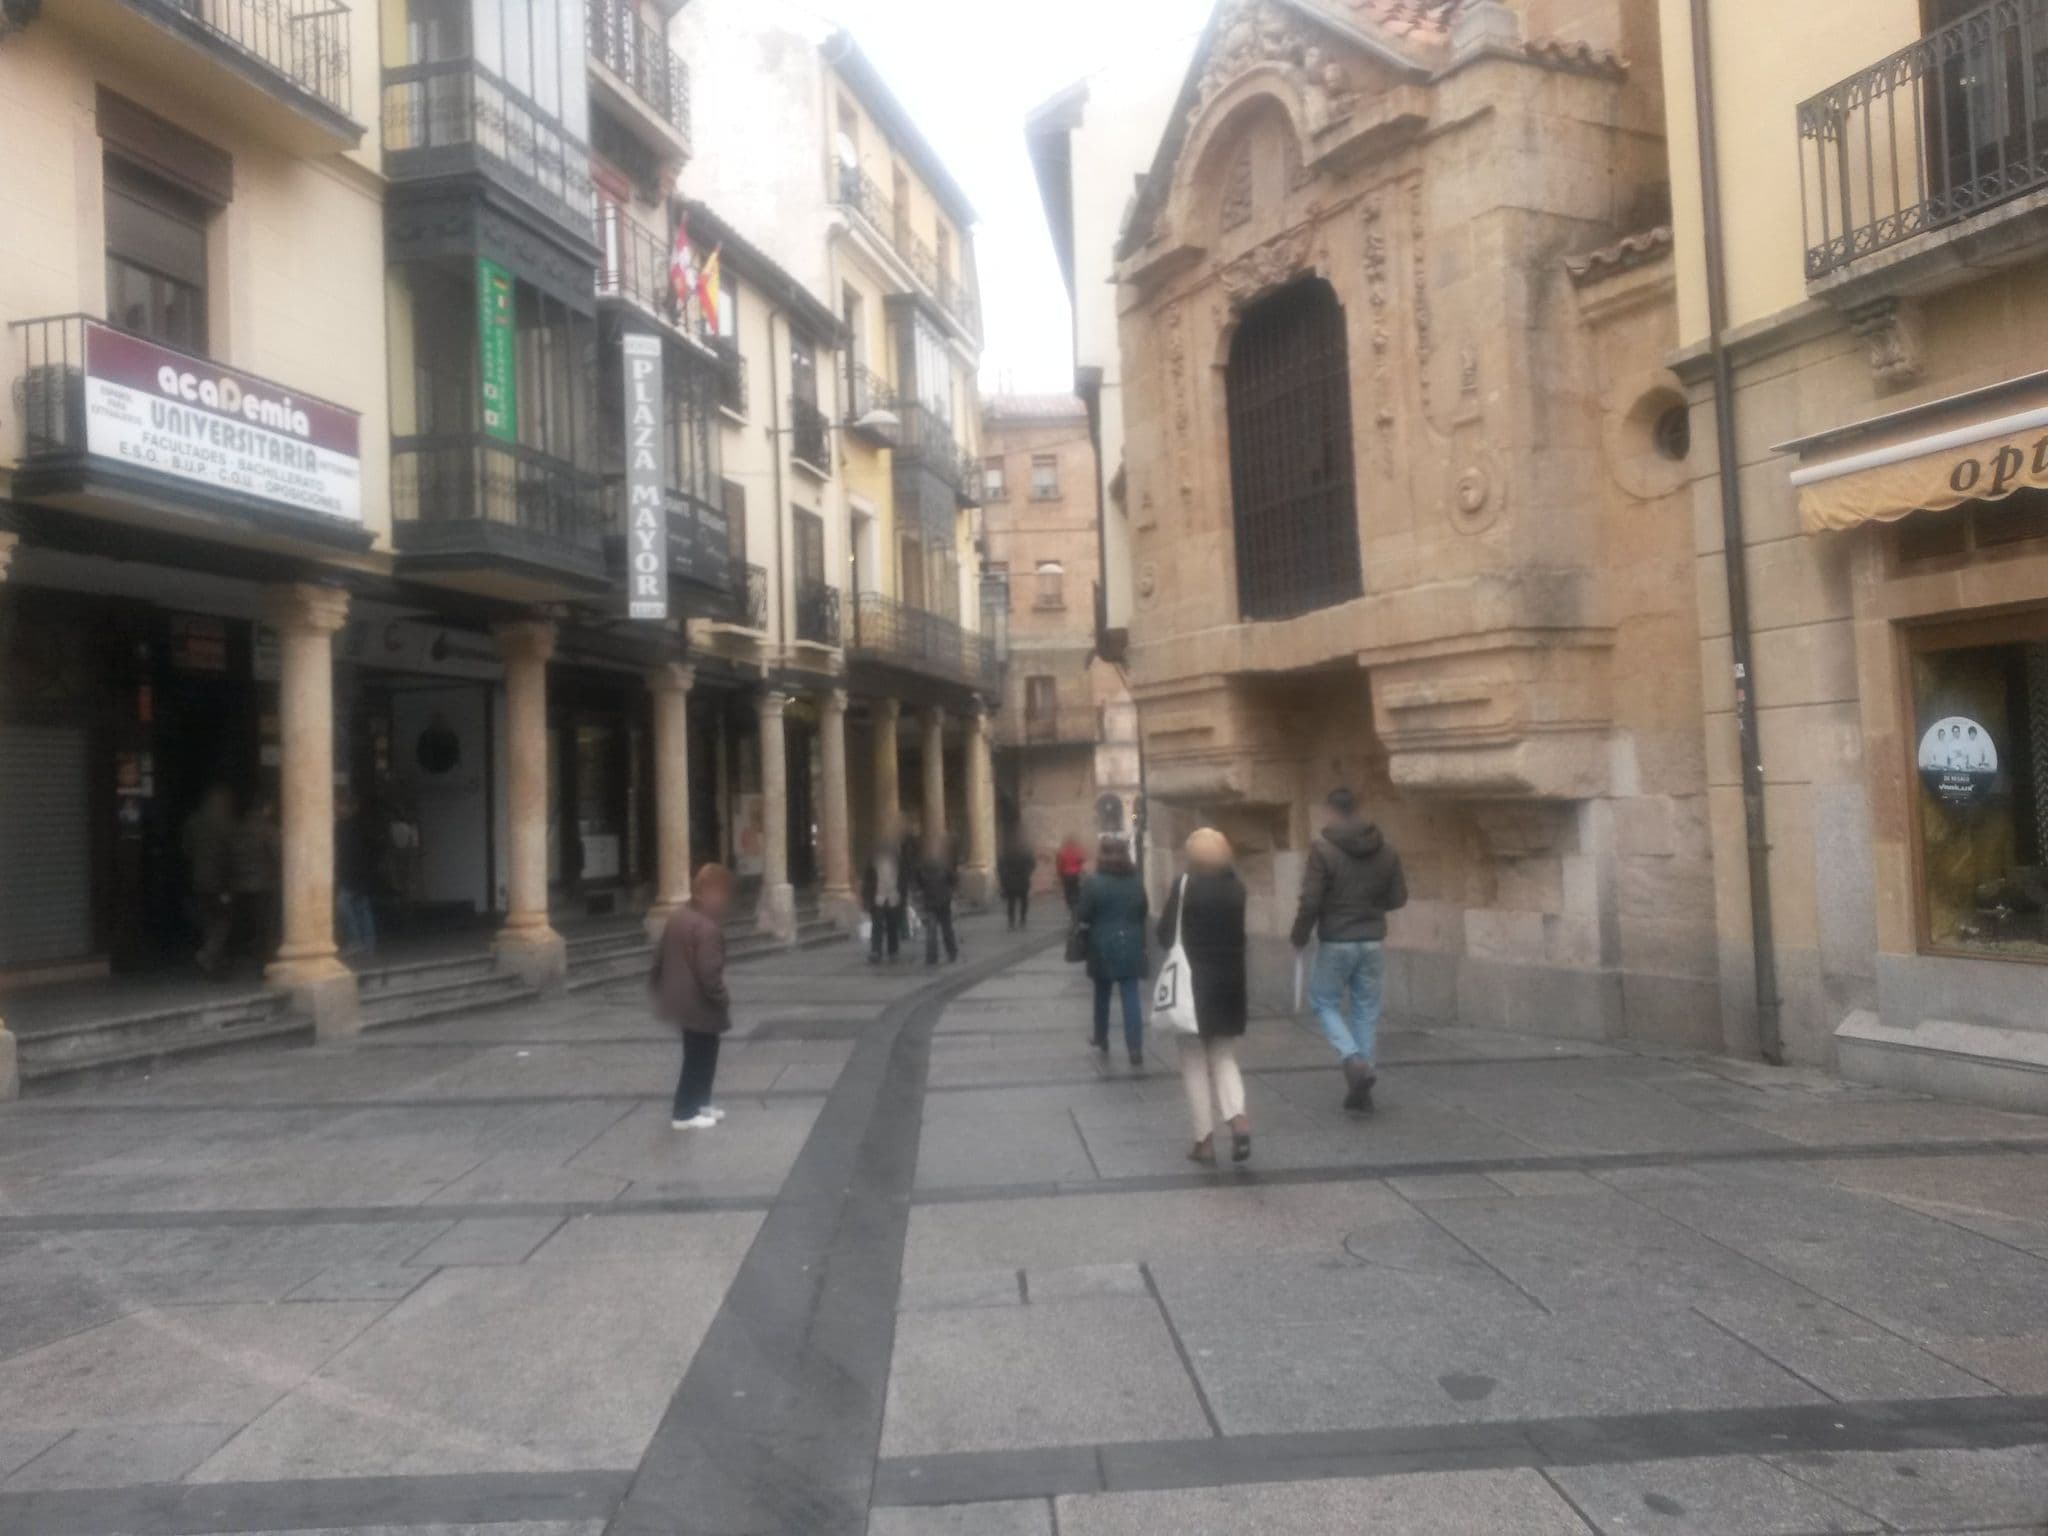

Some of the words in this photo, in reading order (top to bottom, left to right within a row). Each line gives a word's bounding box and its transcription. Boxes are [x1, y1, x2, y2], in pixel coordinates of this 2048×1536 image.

[151, 399, 317, 474] UNIVERSITARIA
[632, 359, 657, 470] PLAZA
[142, 431, 227, 466] FACULTADES
[238, 457, 326, 493] BACHILLERATO
[264, 479, 342, 512] OPOSICIONES
[631, 484, 660, 596] MAYOR
